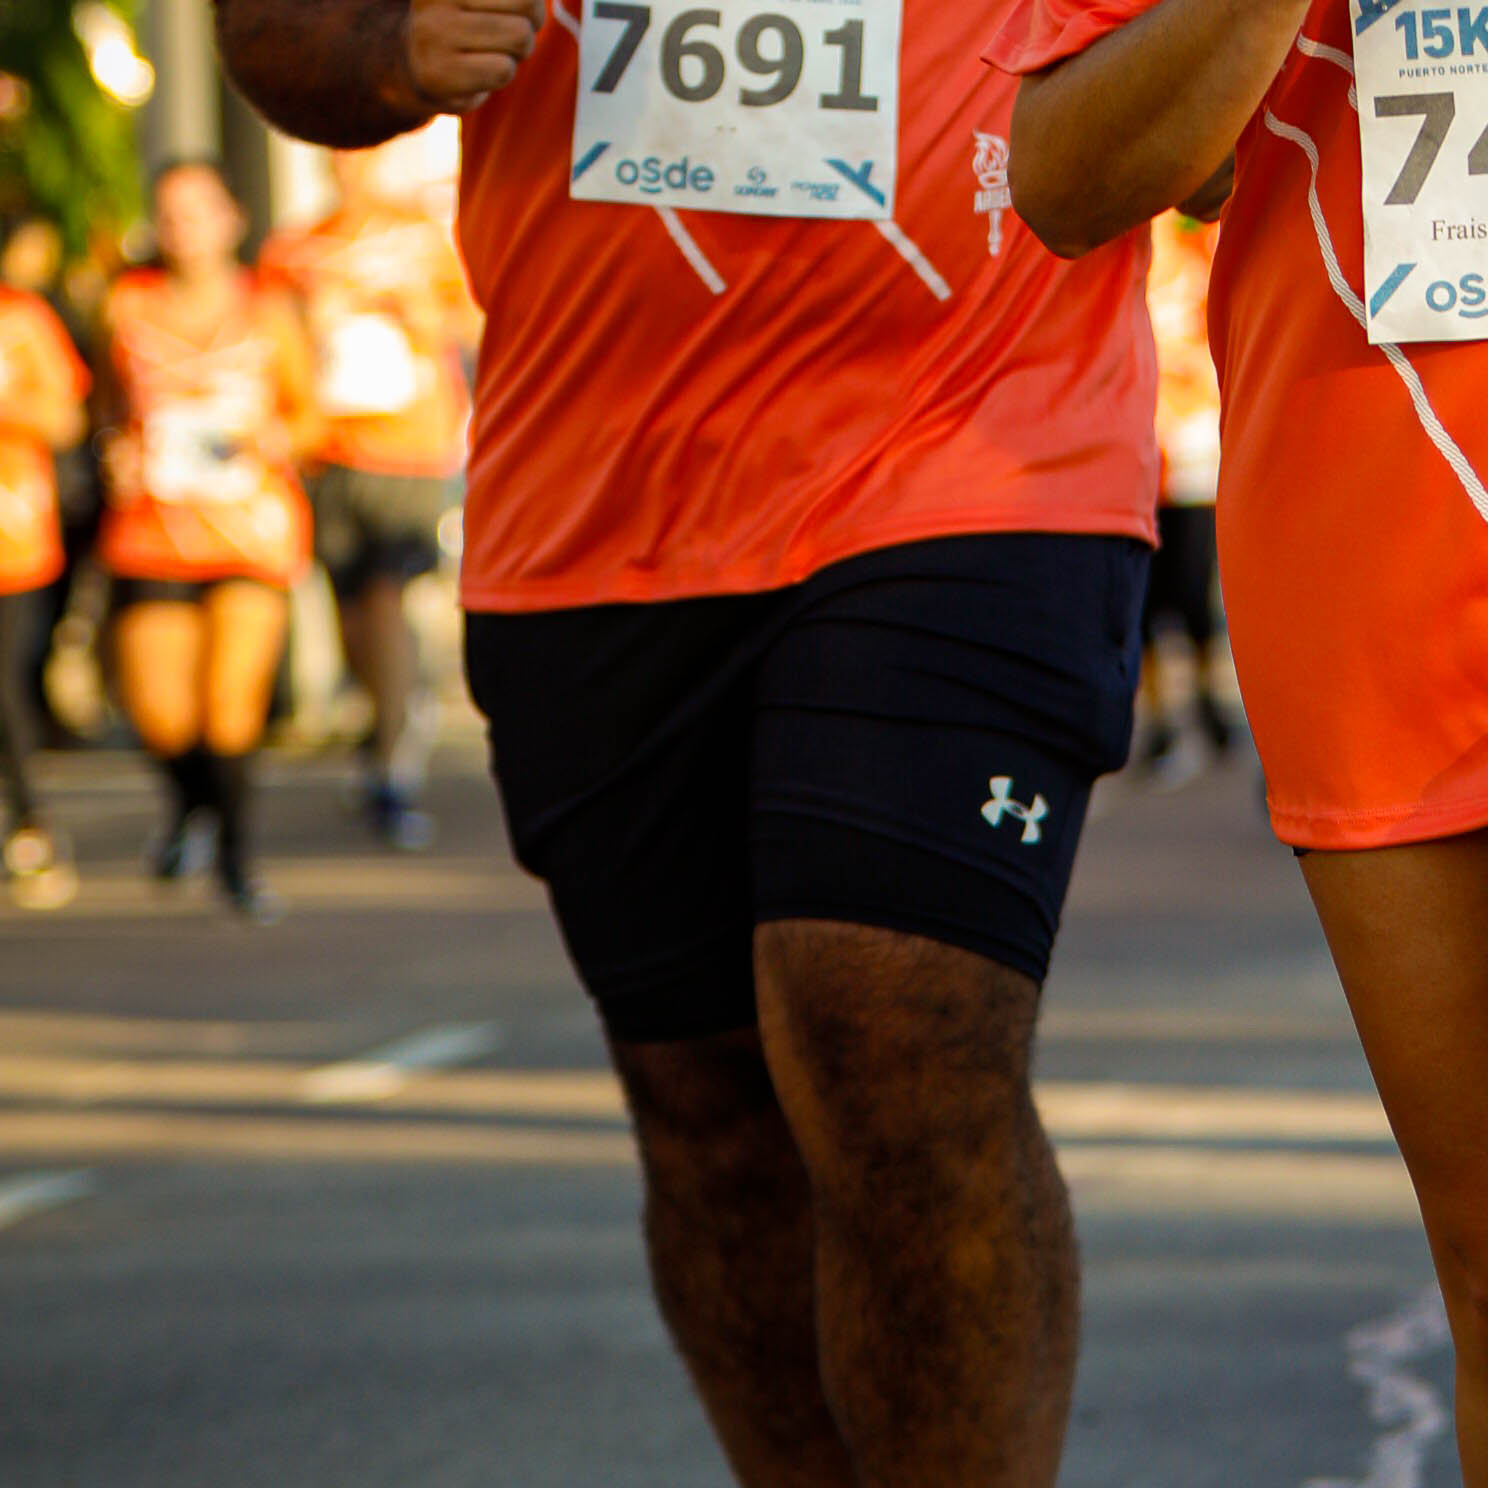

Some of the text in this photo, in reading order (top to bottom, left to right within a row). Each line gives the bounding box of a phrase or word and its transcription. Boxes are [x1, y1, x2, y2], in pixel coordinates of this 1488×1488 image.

[590, 0, 879, 112] 7691
[1399, 66, 1446, 79] PUERTO
[1449, 63, 1488, 76] NORTE
[615, 156, 714, 194] osde
